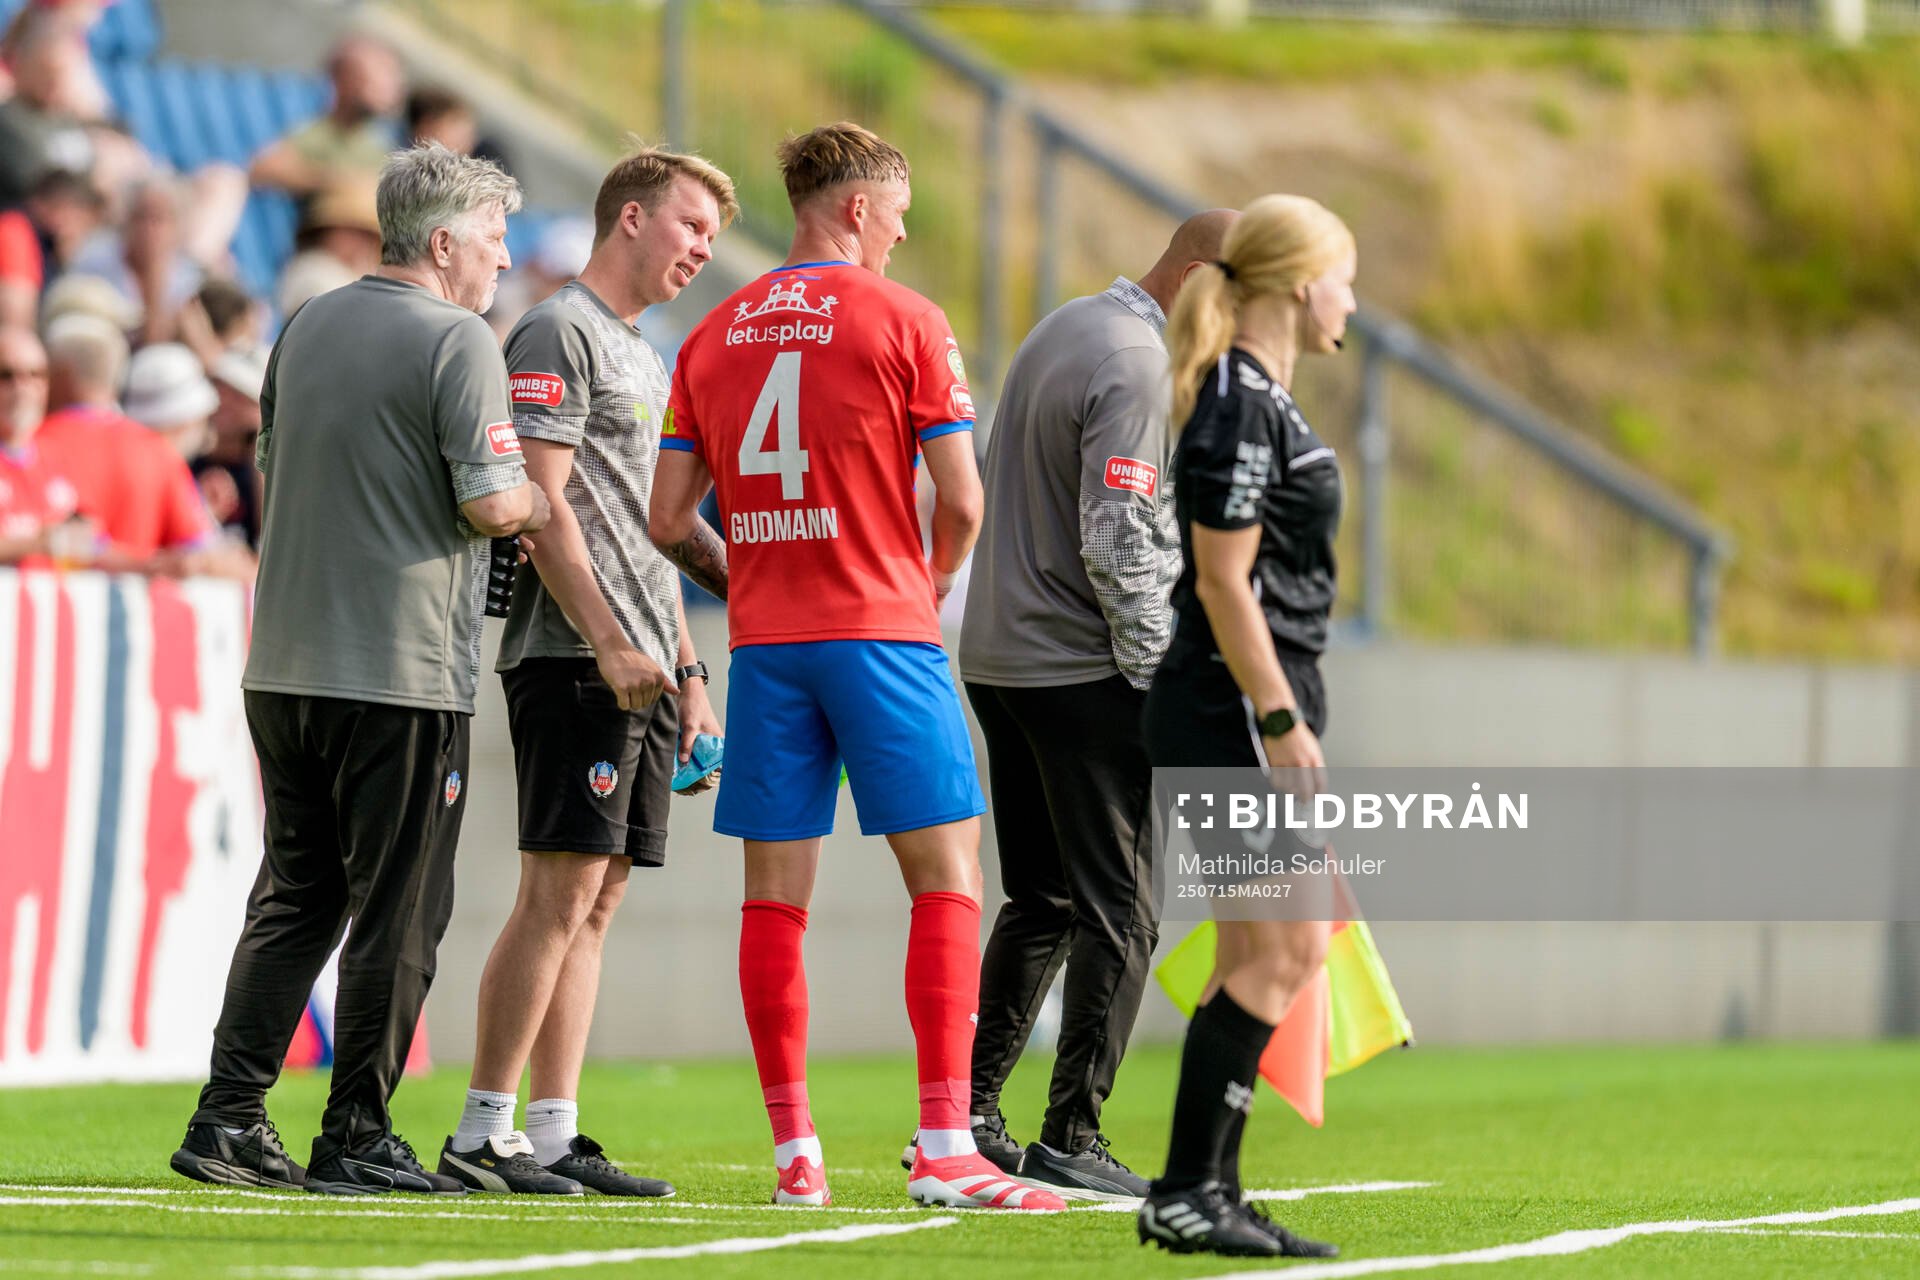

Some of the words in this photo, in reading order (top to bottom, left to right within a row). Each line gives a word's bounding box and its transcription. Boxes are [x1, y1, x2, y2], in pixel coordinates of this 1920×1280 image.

[725, 320, 834, 346] letusplay
[509, 378, 560, 394] UNIBET
[738, 351, 809, 500] 4
[1111, 463, 1155, 485] UNIBET
[731, 507, 839, 544] GUDMANN
